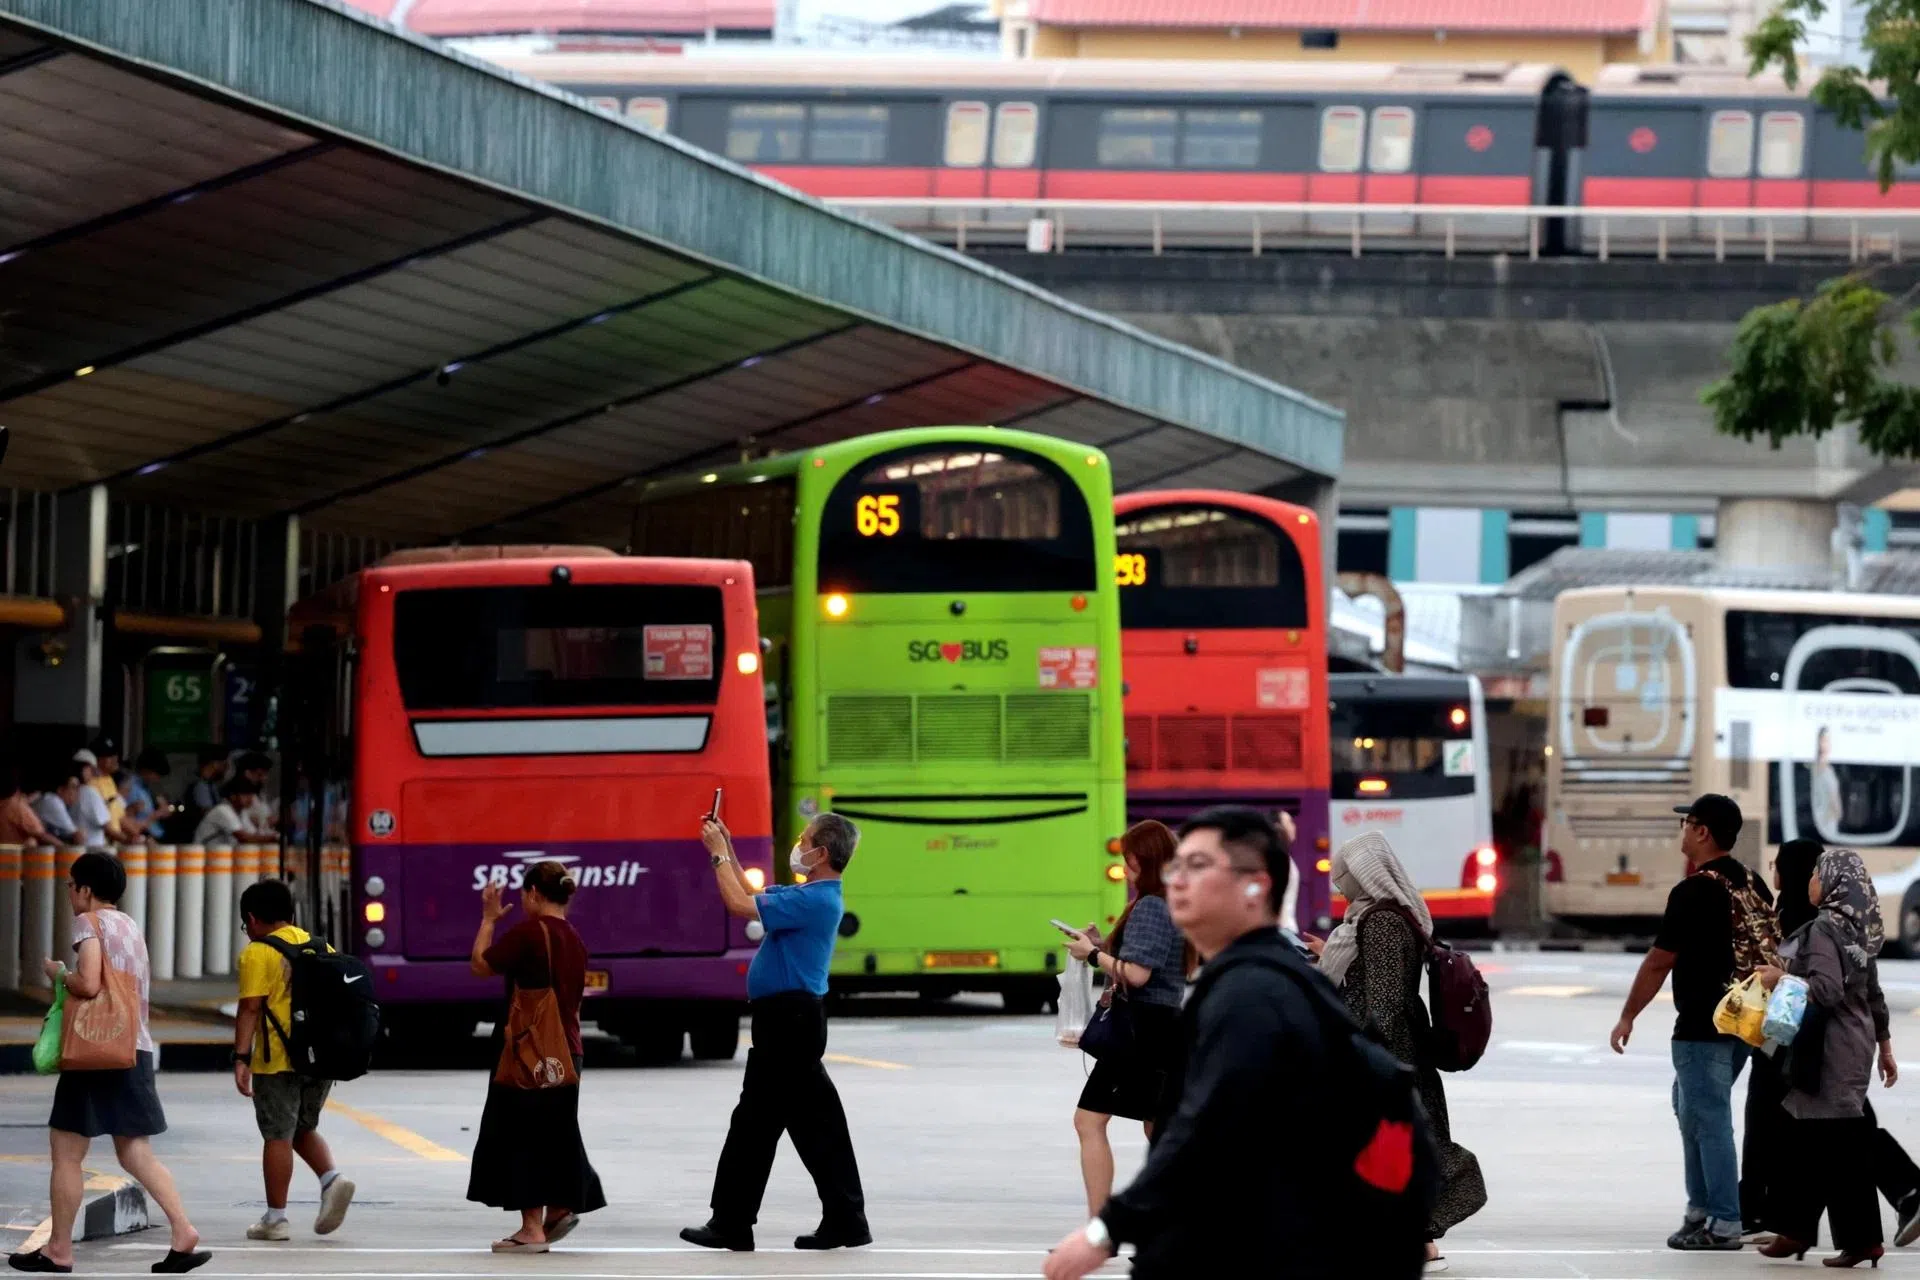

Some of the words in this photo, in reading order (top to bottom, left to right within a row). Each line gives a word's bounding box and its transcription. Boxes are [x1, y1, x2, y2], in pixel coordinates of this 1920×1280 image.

[857, 495, 900, 536] 65
[167, 675, 201, 702] 65
[472, 863, 525, 891] SBS
